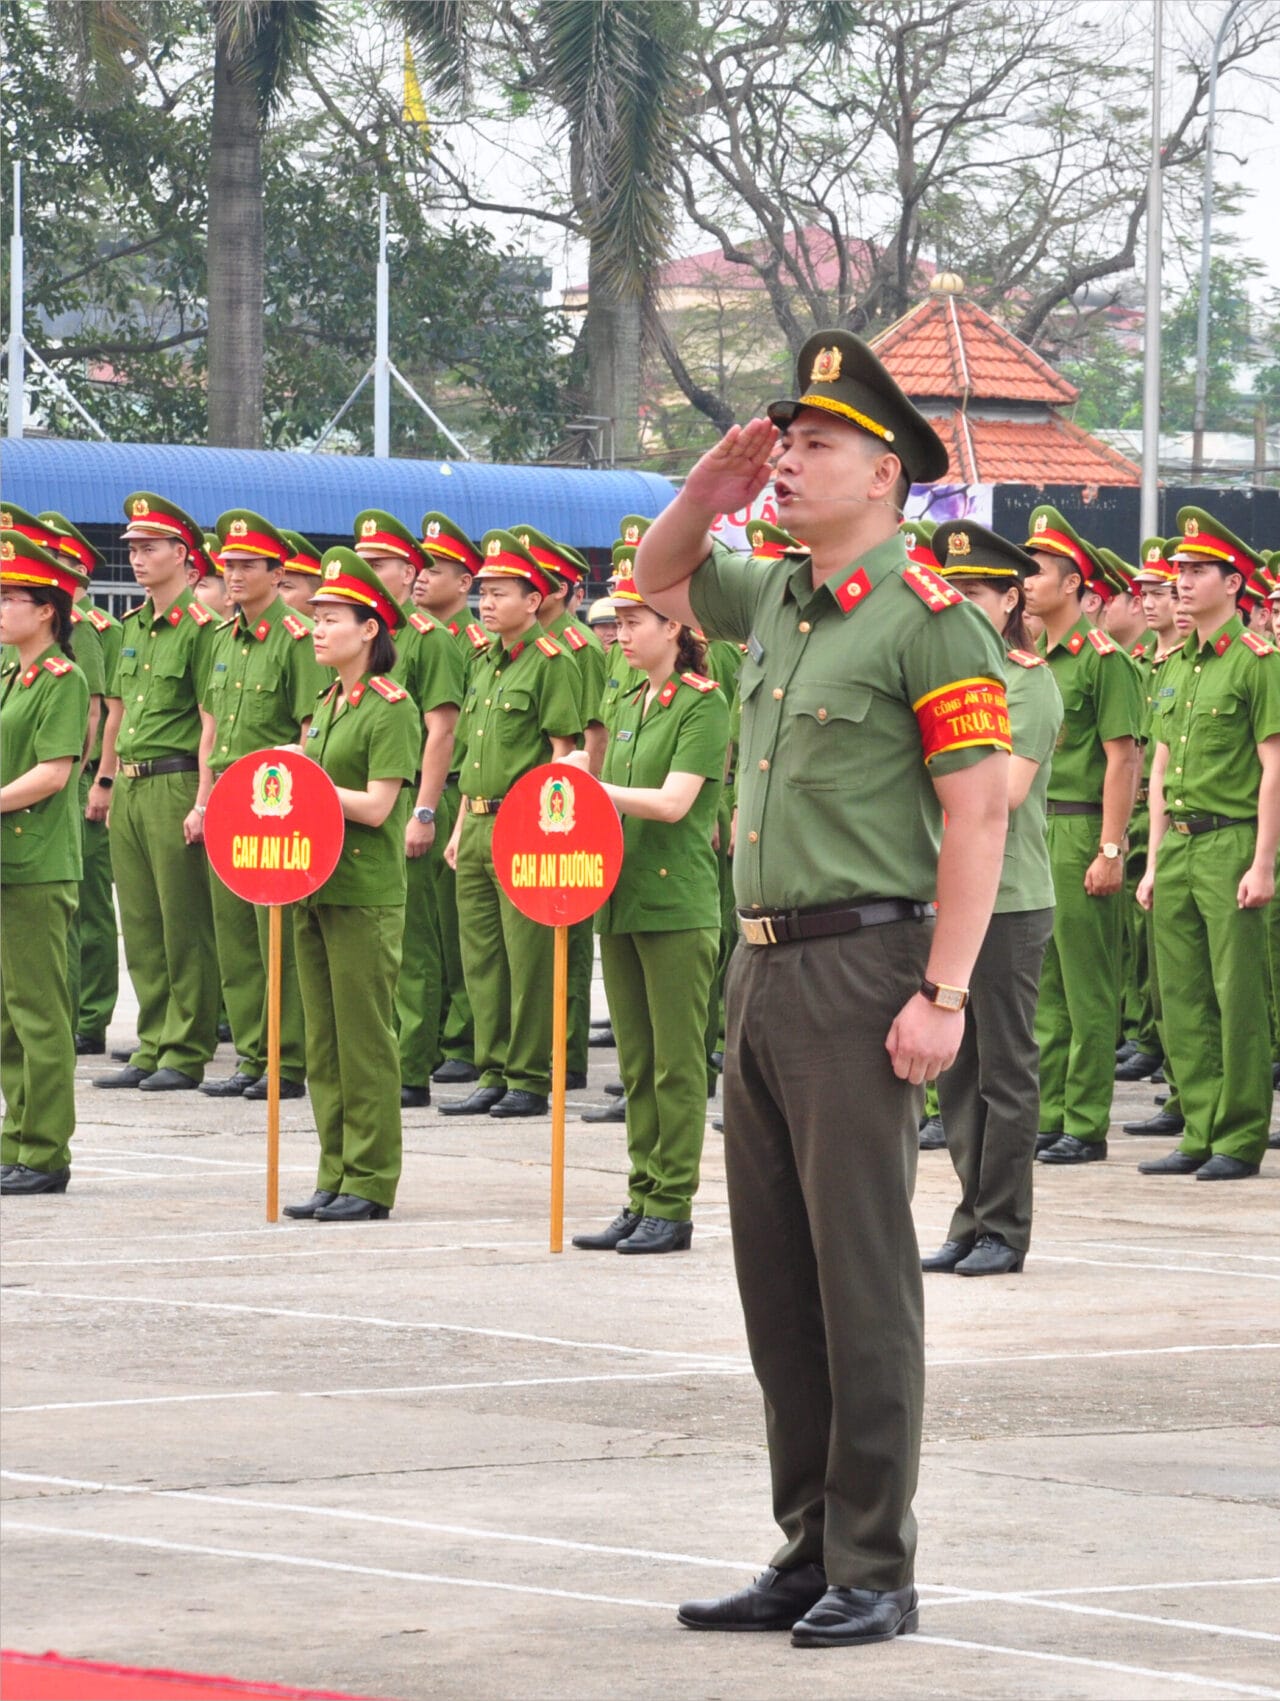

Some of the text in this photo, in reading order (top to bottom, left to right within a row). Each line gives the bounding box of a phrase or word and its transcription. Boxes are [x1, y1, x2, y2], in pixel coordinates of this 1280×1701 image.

[933, 698, 962, 717] CÔNG
[964, 691, 979, 705] AN
[946, 708, 995, 736] TRỰC
[232, 830, 311, 871] CAH AN LÃO
[512, 853, 536, 887] CAH
[539, 853, 556, 887] AN
